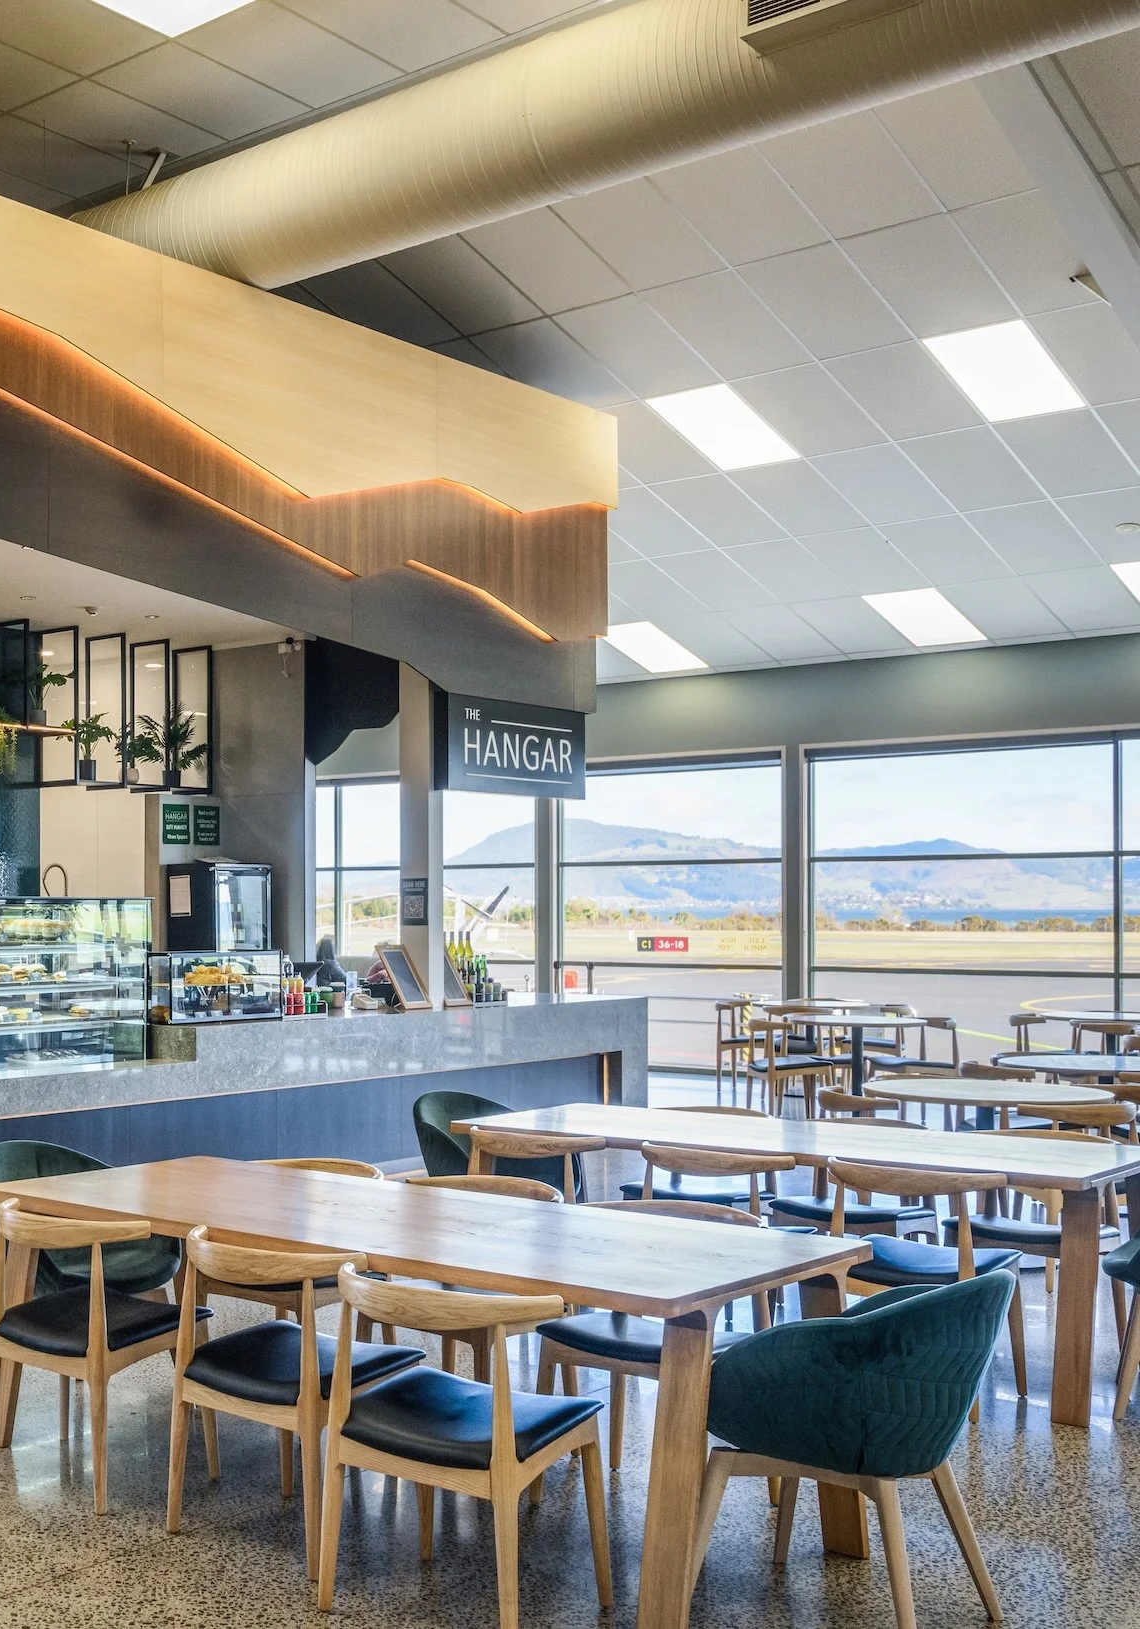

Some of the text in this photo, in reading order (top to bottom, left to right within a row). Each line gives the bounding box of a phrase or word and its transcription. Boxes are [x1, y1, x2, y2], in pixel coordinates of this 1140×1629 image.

[464, 708, 480, 720] THE
[464, 727, 573, 774] HANGAR
[641, 940, 684, 949] C1 36-18
